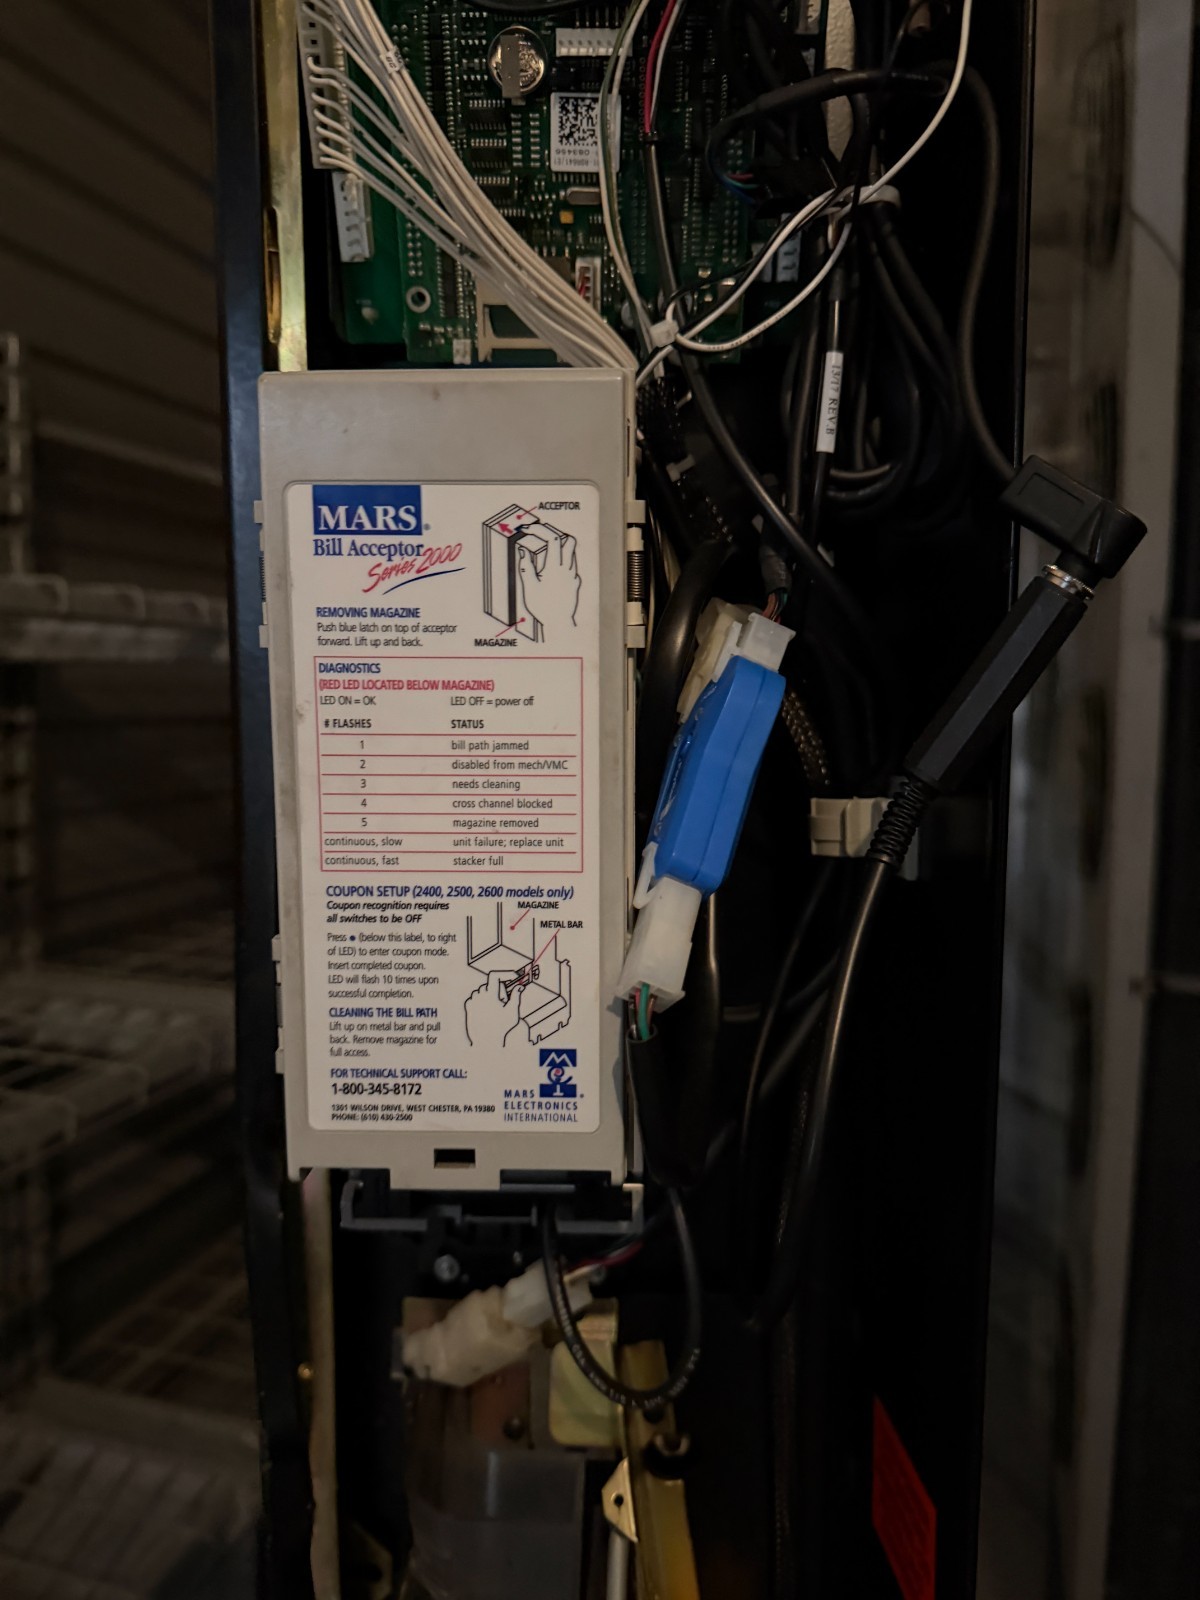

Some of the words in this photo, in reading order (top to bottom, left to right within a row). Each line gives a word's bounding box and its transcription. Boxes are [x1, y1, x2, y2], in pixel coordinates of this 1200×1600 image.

[538, 502, 580, 510] ACCEPTOR
[318, 505, 417, 531] MARS
[313, 539, 343, 556] Bill
[347, 539, 424, 561] Acceptor
[362, 556, 415, 593] Series
[415, 543, 462, 574] 2000
[316, 607, 367, 617] REMOVING
[370, 608, 420, 618] MAGAZINE
[317, 622, 336, 632] Push
[339, 623, 356, 632] blue
[359, 623, 378, 632] latch
[395, 624, 409, 634] top
[411, 622, 420, 632] of
[422, 625, 457, 635] acceptor
[317, 636, 352, 646] forward.
[355, 636, 367, 646] Lift
[370, 639, 381, 648] up
[383, 637, 399, 646] and
[401, 637, 423, 646] back.
[318, 663, 381, 673] DIAGNOSTICS
[319, 680, 340, 691] (RED
[343, 680, 360, 689] LED
[362, 680, 404, 690] LOCATED
[406, 680, 440, 690] BELOW
[442, 680, 494, 692] MAGAZINE)
[320, 696, 336, 705] LED
[338, 696, 352, 705] ON
[363, 696, 376, 705] OK
[451, 696, 466, 705] LED
[469, 696, 484, 706] OFF
[495, 699, 521, 708] power
[523, 696, 534, 706] off
[333, 719, 371, 728] FLASHES
[451, 720, 484, 728] STATUS
[360, 740, 364, 749] 1
[452, 740, 465, 750] bill
[469, 741, 489, 752] path
[492, 741, 529, 752] jammed
[360, 759, 366, 769] 2
[452, 760, 489, 769] disabled
[493, 760, 515, 769] from
[518, 760, 568, 769] mech/VMC
[361, 779, 366, 788] 3
[452, 779, 479, 788] needs
[482, 779, 520, 791] cleaning
[361, 798, 367, 807] 4
[479, 799, 514, 808] channel
[517, 799, 552, 808] blocked
[362, 817, 367, 827] 5
[453, 820, 497, 831] magazine
[500, 818, 538, 827] removed
[324, 837, 378, 848] continuous,
[381, 836, 402, 846] slow
[453, 837, 471, 846] unit
[475, 837, 506, 847] failure;
[510, 837, 542, 848] replace
[325, 856, 378, 867] continuous,
[382, 855, 399, 865] fast
[454, 856, 485, 865] stacker
[489, 856, 503, 865] full
[326, 886, 373, 896] COUPON
[377, 886, 410, 897] SETUP
[413, 885, 443, 898] (2400,
[447, 886, 474, 898] 2500,
[477, 886, 503, 897] 2600
[506, 886, 544, 897] models
[547, 886, 574, 900] only)
[327, 901, 360, 911] Coupon
[363, 901, 412, 911] recognition
[414, 901, 449, 911] requires
[518, 901, 559, 909] MAGAZINE
[327, 914, 338, 922] all
[340, 914, 376, 923] switches
[380, 915, 389, 923] to
[391, 914, 402, 923] be
[405, 914, 422, 923] OFF
[327, 933, 347, 942] Press
[359, 933, 386, 942] (below
[388, 933, 402, 941] this
[404, 933, 424, 943] label,
[427, 934, 436, 942] to
[438, 933, 456, 944] right
[328, 946, 336, 955] of
[339, 947, 356, 956] LED)
[359, 948, 367, 956] to
[369, 948, 390, 956] enter
[392, 949, 423, 959] coupon
[425, 947, 449, 956] mode.
[328, 961, 349, 969] Insert
[351, 961, 392, 971] completed
[394, 963, 426, 972] coupon.
[328, 975, 343, 984] LED
[346, 975, 359, 983] will
[362, 974, 379, 984] flash
[383, 975, 393, 983] 10
[395, 976, 416, 984] times
[418, 977, 439, 987] upon
[328, 988, 366, 998] successful
[369, 989, 414, 999] completion.
[329, 1008, 373, 1017] CLEANING
[376, 1008, 393, 1017] THE
[396, 1008, 413, 1017] BILL
[416, 1008, 437, 1017] PATH
[330, 1021, 341, 1030] Lift
[344, 1024, 354, 1032] up
[370, 1022, 391, 1031] metal
[394, 1022, 407, 1031] bar
[409, 1022, 424, 1031] and
[427, 1022, 440, 1033] pull
[330, 1035, 349, 1044] back.
[353, 1035, 384, 1044] Remove
[386, 1037, 424, 1047] magazine
[426, 1035, 437, 1044] for
[330, 1047, 342, 1056] full
[344, 1049, 370, 1057] access.
[331, 1069, 348, 1078] FOR
[350, 1069, 398, 1078] TECHNICAL
[401, 1069, 441, 1078] SUPPORT
[443, 1069, 467, 1079] CALL:
[332, 1083, 422, 1095] 1-800-345-8172
[504, 1089, 535, 1098] MARS
[504, 1101, 577, 1110] ELECTRONICS
[361, 1113, 379, 1122] (610)
[381, 1113, 413, 1121] 430-2500
[504, 1113, 578, 1122] INTERNATIONAL
